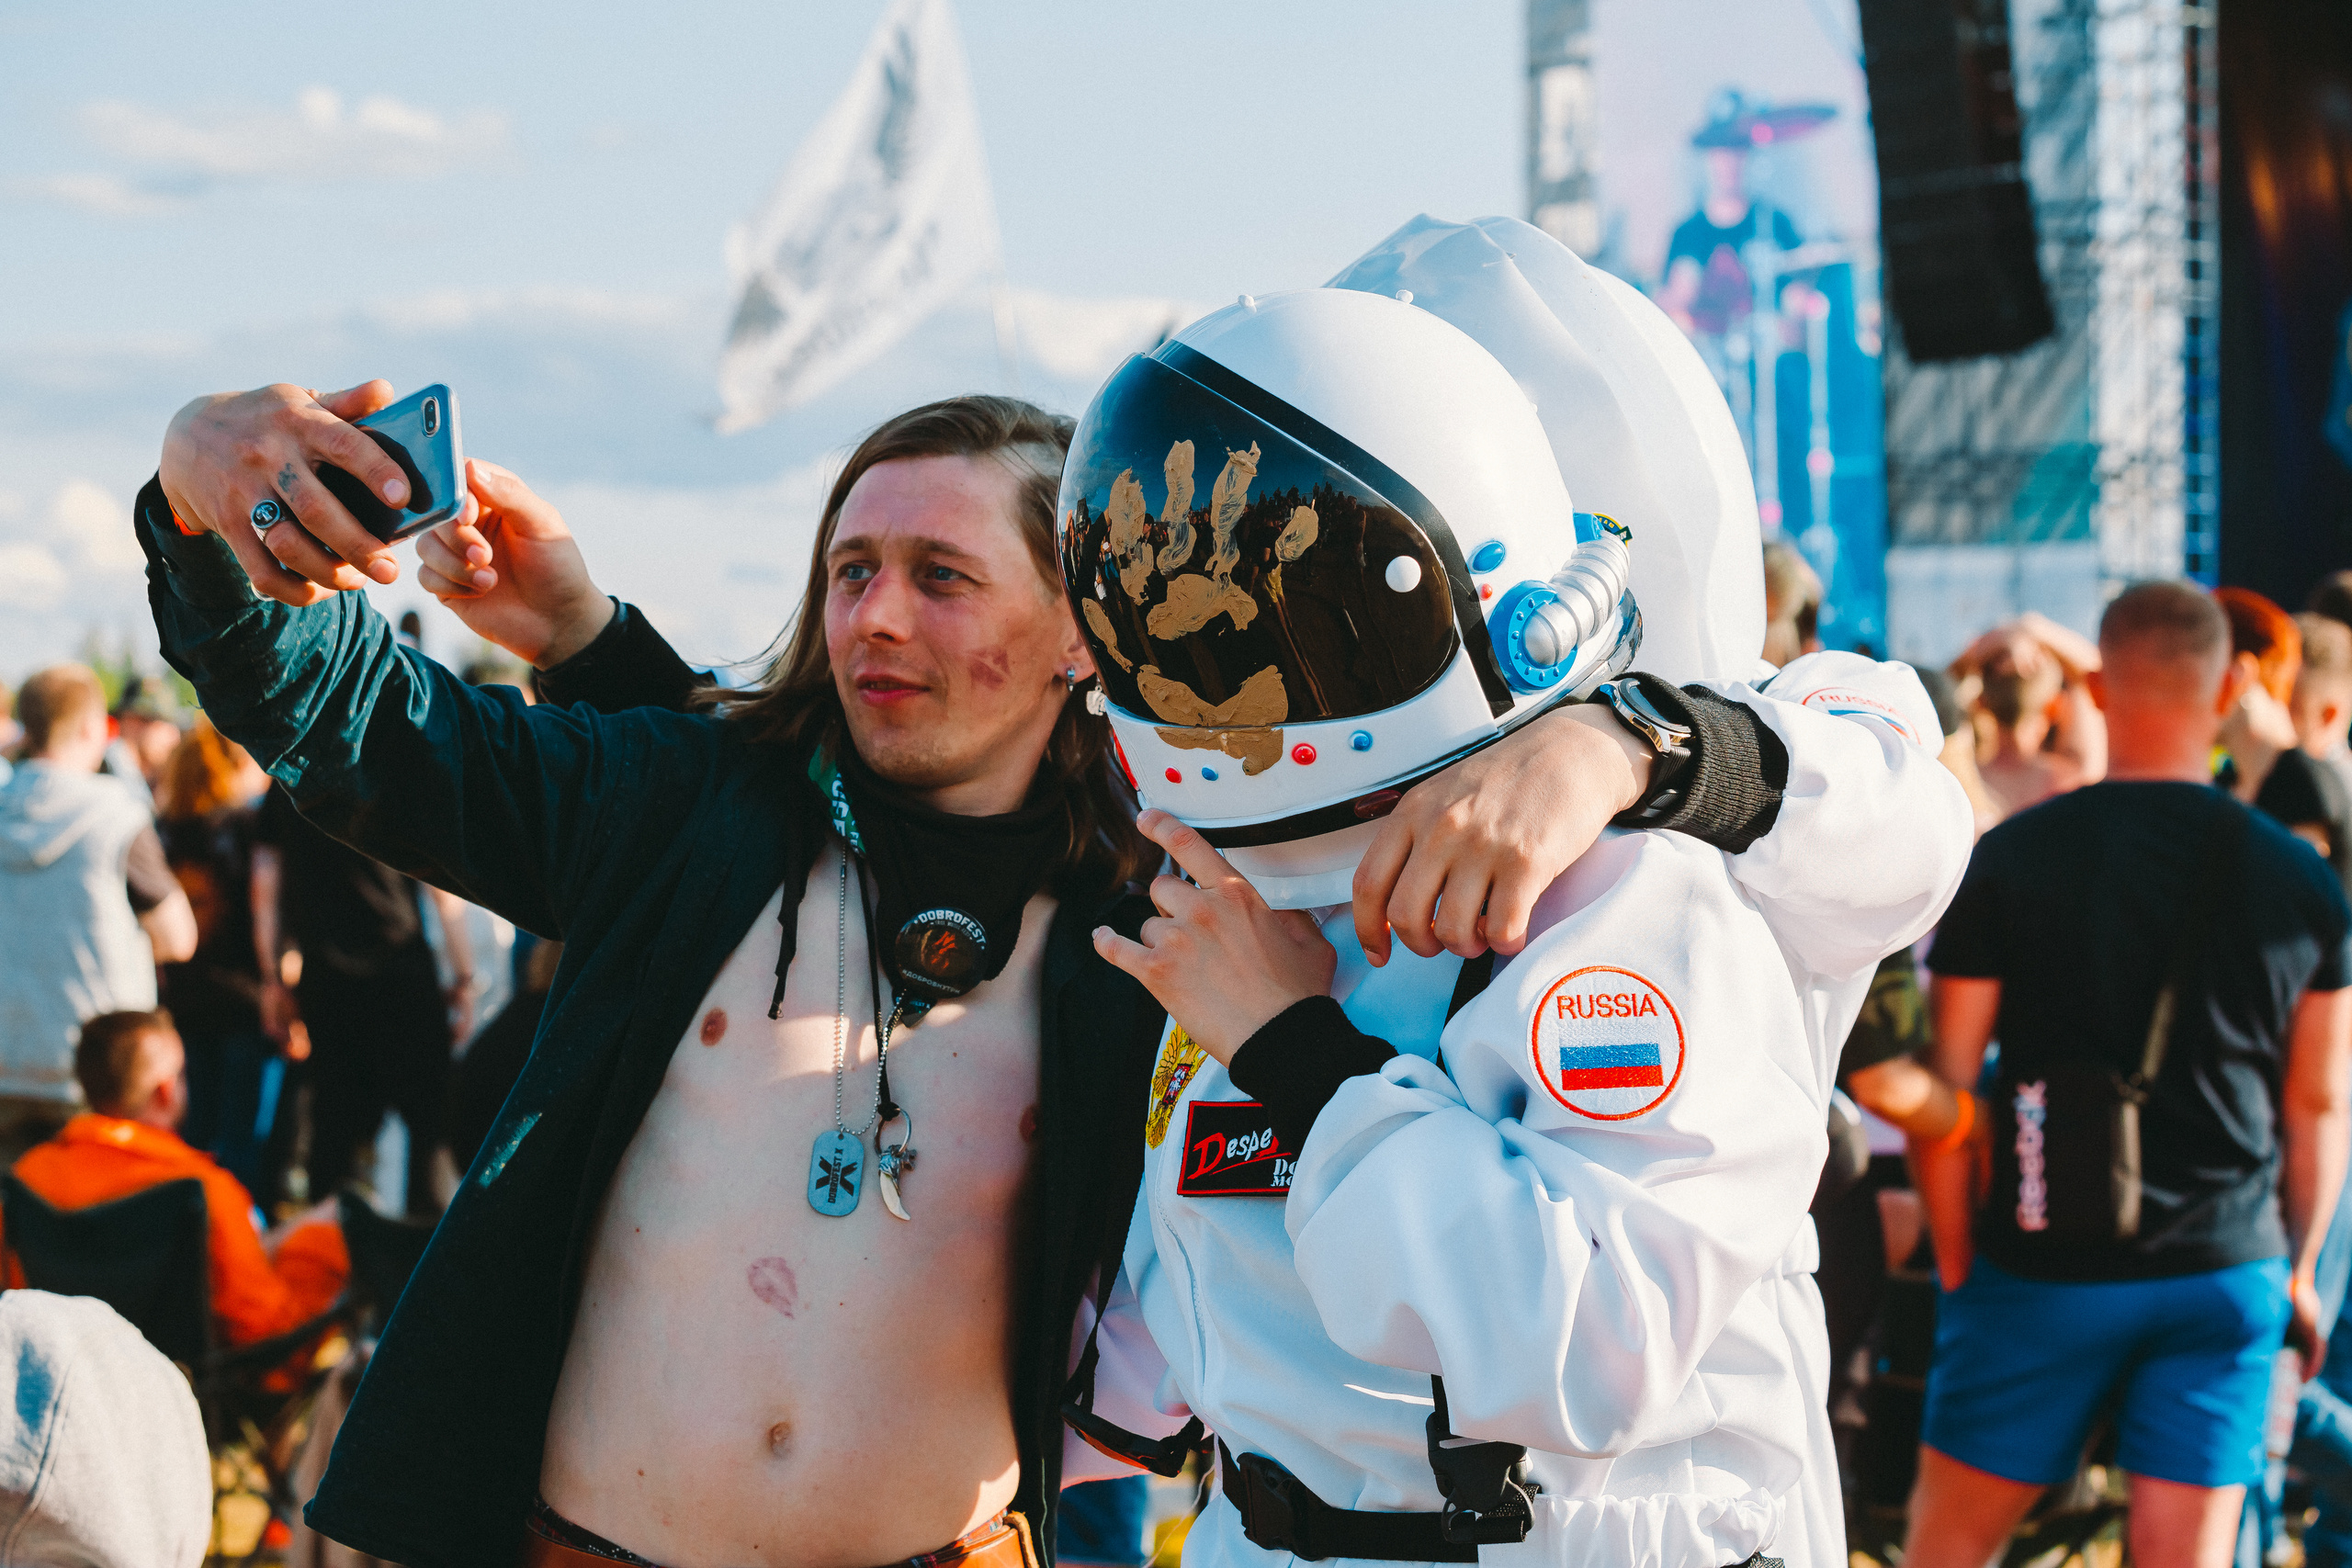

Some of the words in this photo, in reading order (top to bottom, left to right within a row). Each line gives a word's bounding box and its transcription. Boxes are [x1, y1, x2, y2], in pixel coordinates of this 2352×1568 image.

[918, 909, 987, 944] DOBROFEST
[1556, 992, 1658, 1020] RUSSIA
[828, 1156, 842, 1203] DOBROFEST
